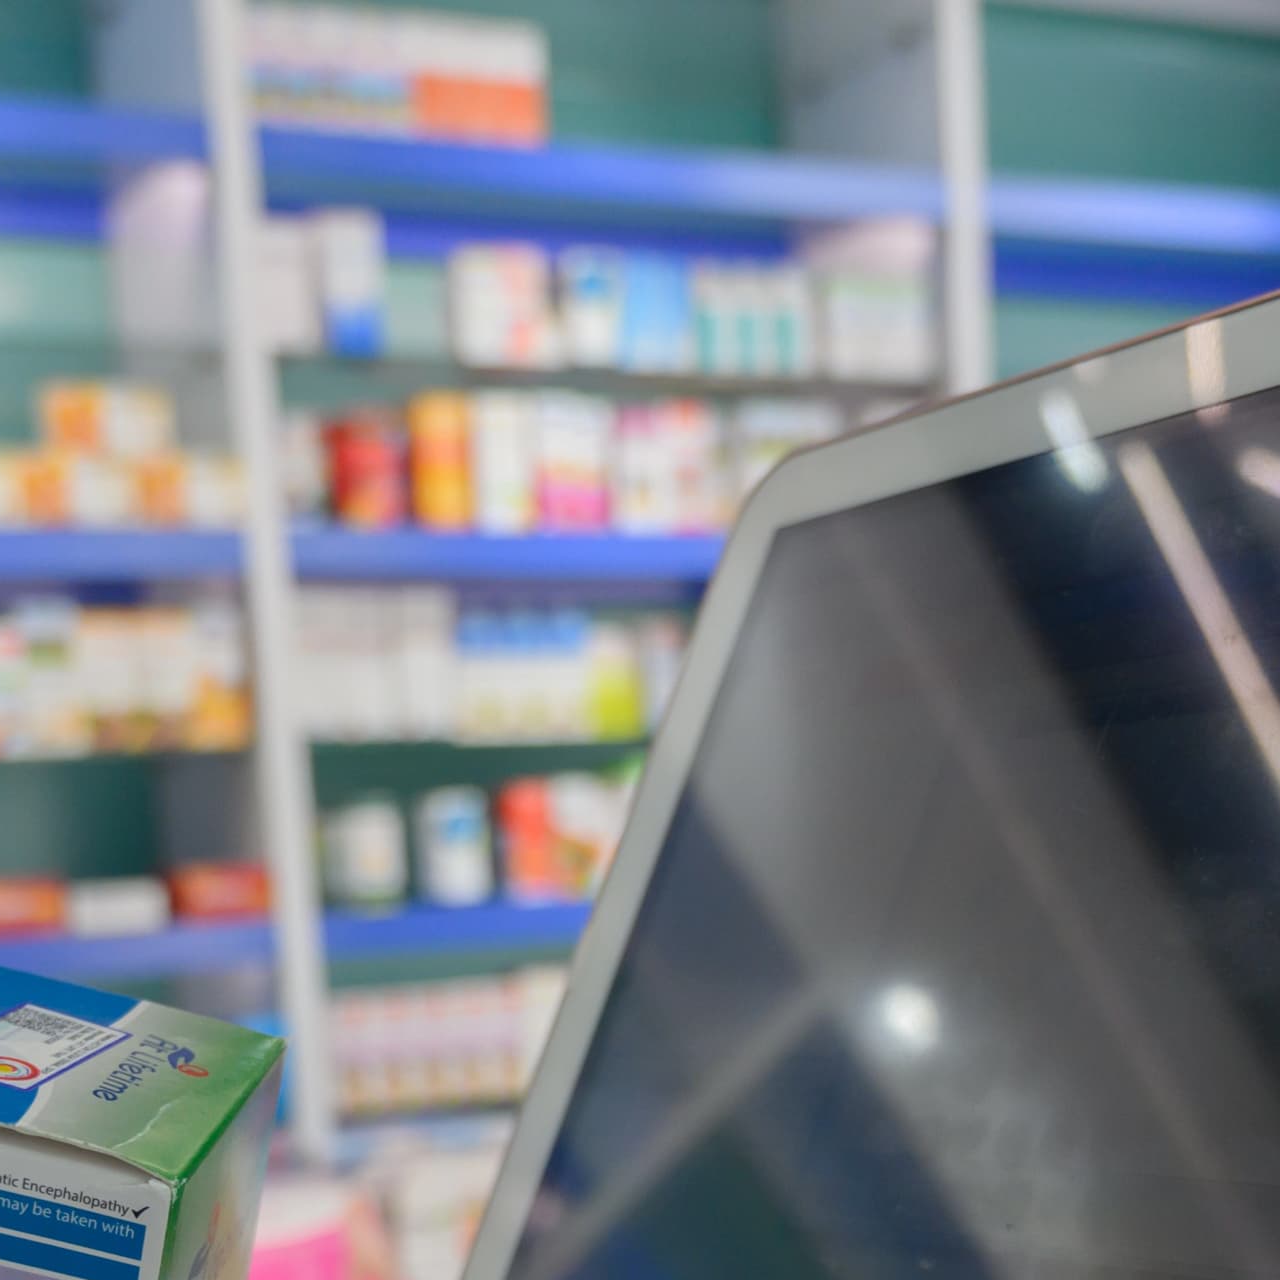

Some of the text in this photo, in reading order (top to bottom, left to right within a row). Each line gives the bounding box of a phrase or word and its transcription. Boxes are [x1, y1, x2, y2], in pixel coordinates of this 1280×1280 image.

[92, 1049, 166, 1101] Lifetime
[22, 1177, 129, 1218] Encephalopathy
[32, 1202, 52, 1219] be
[56, 1209, 97, 1230] taken
[101, 1222, 135, 1239] with
